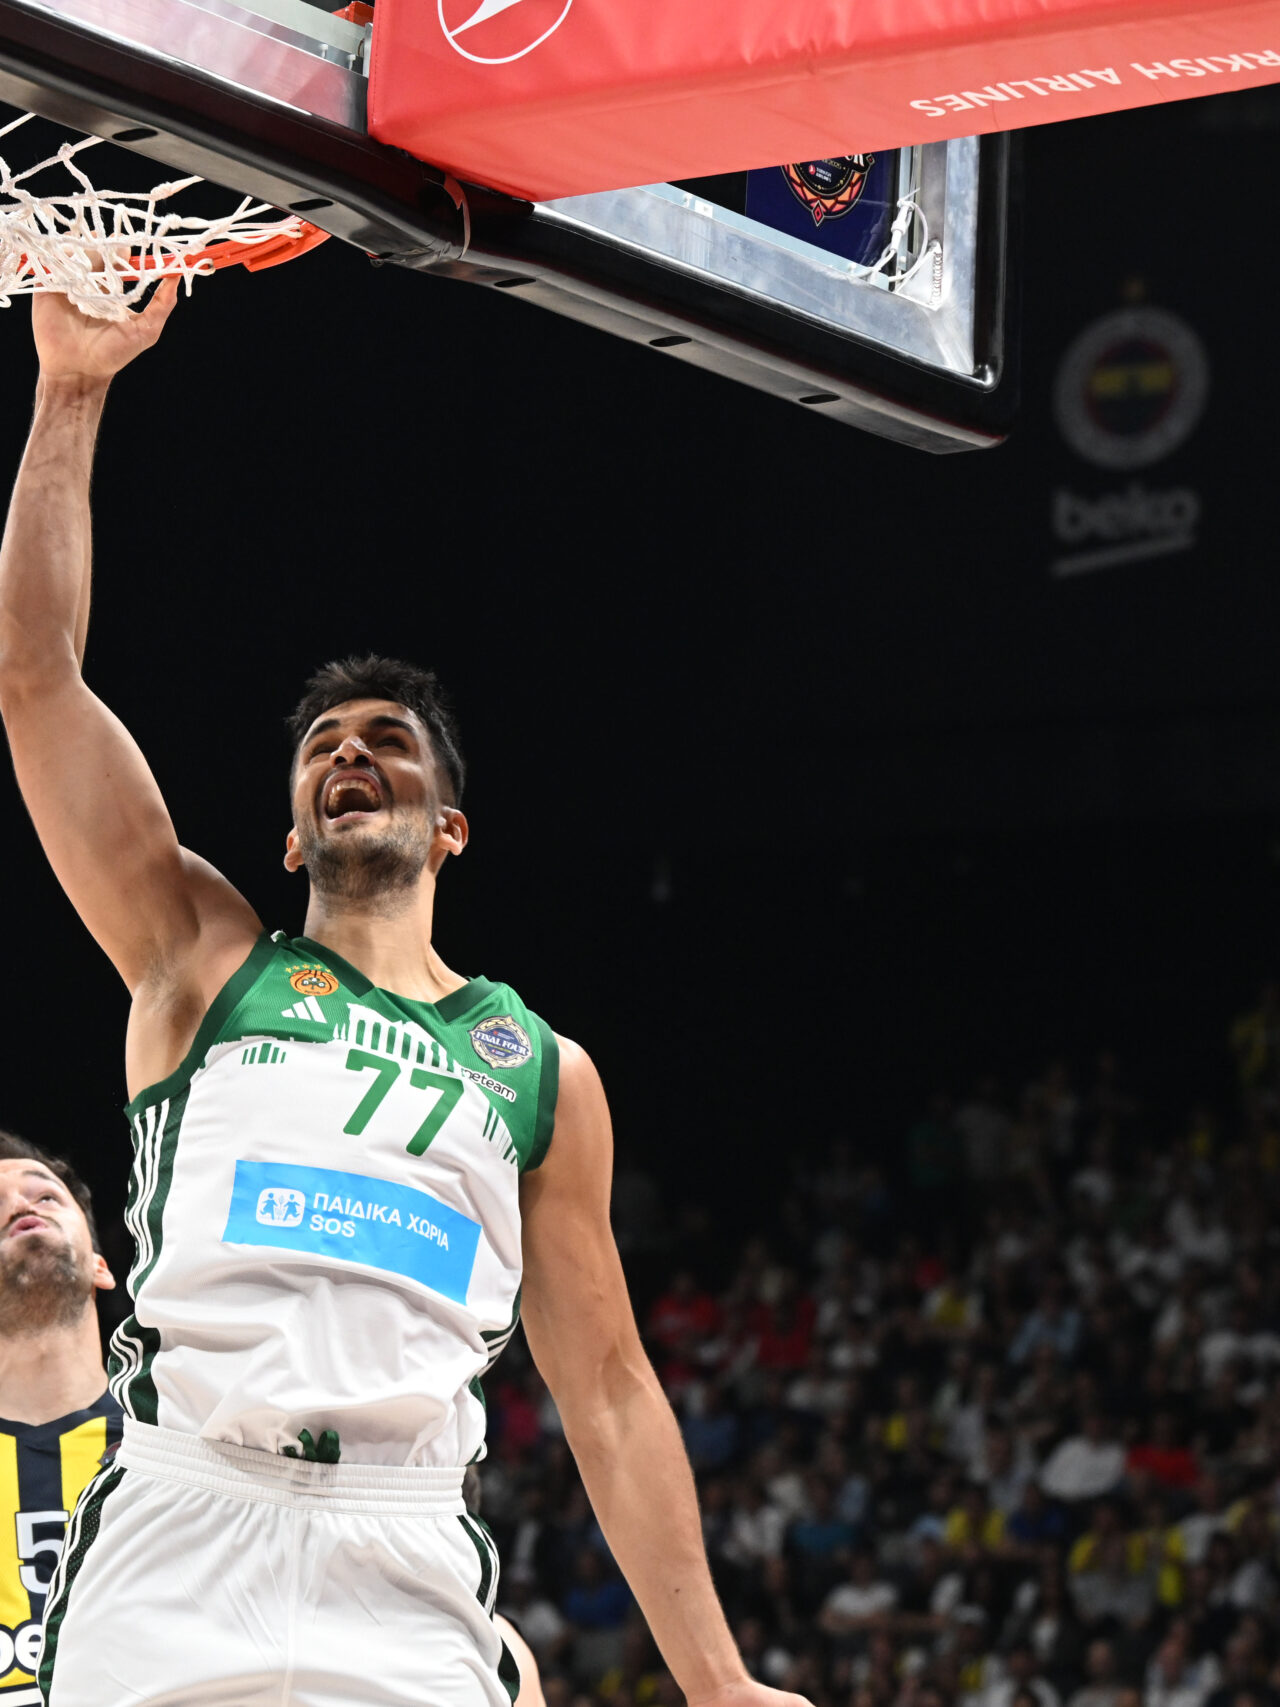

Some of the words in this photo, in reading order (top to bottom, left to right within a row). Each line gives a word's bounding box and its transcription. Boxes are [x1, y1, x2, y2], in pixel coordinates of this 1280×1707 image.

[1130, 50, 1280, 80] RKISH
[910, 67, 1122, 117] AIRLINES
[475, 1031, 500, 1046] FINAL
[502, 1040, 528, 1056] FOUR
[342, 1048, 465, 1157] 77
[463, 1068, 516, 1101] neteam
[309, 1214, 356, 1238] SOS
[313, 1192, 401, 1227] ΠΑΙΔΙΚΑ
[406, 1213, 449, 1251] ΧΩΡΙΑ
[15, 1510, 69, 1594] 5
